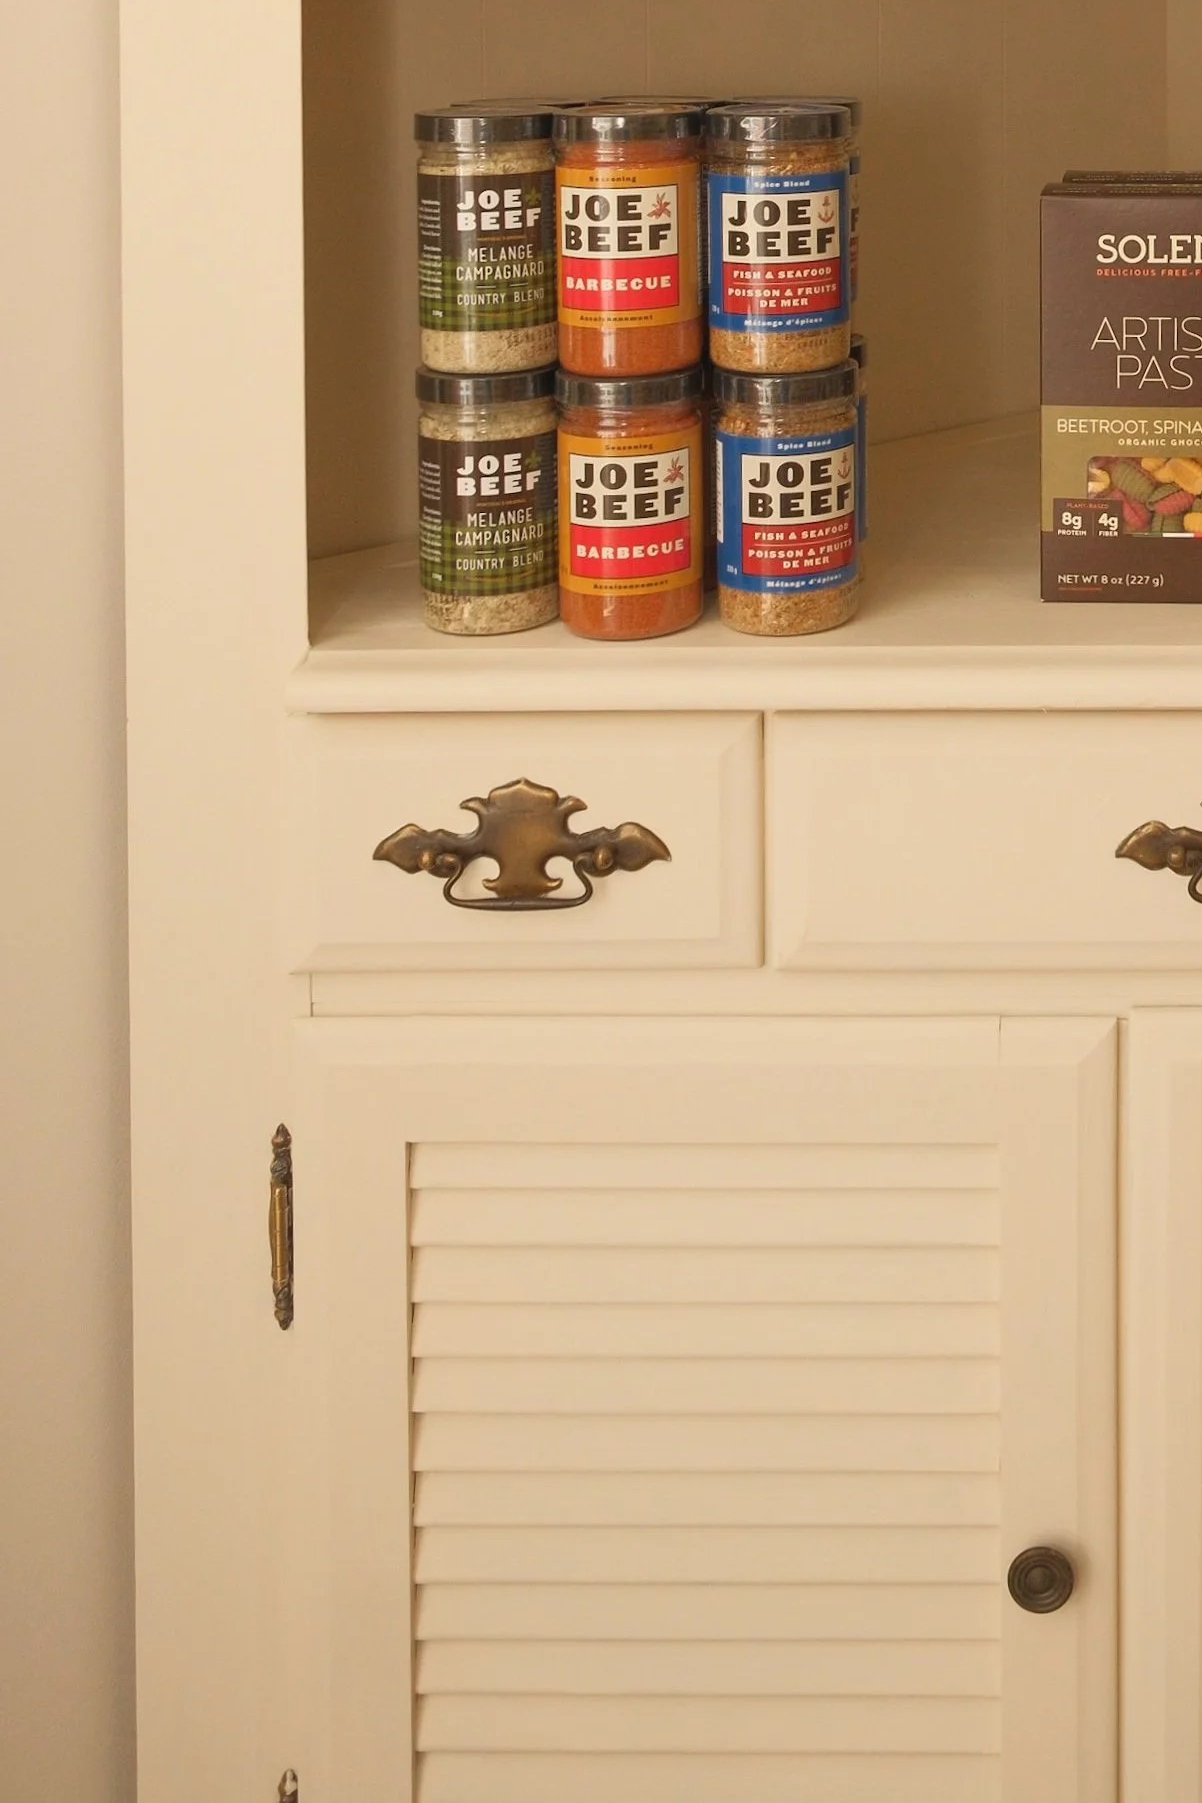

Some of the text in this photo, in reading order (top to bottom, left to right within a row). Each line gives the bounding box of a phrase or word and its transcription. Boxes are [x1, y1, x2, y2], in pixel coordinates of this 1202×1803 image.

[457, 189, 522, 211] JOE
[565, 194, 642, 222] JOE
[457, 208, 541, 231] BEEF
[728, 199, 811, 227] JOE
[565, 223, 671, 252] BEEF
[728, 227, 835, 257] BEEF
[456, 261, 544, 281] CAMPAGNARD
[733, 267, 832, 279] FISH SEAFOOD
[1096, 269, 1157, 277] DELICIOUS
[566, 276, 671, 292] BARBECUE
[728, 284, 836, 297] POISSON FRUITS
[457, 288, 545, 306] COUNTRY BLEND
[1057, 418, 1149, 436] BEETROOT,
[1118, 438, 1166, 446] ORGANIC
[457, 453, 522, 476] JOE
[748, 457, 832, 488] JOE
[456, 470, 541, 497] BEEF
[576, 461, 658, 490] JOE
[575, 487, 684, 520] BEEF
[748, 482, 852, 519] BEEF
[1061, 512, 1083, 530] 8g
[1098, 513, 1119, 530] 4g
[456, 523, 544, 546] CAMPAGNARD
[1057, 529, 1087, 537] PROTEIN
[576, 539, 684, 559] BARBECUE
[748, 549, 803, 559] POISSON
[456, 551, 544, 571] COUNTRY BLEND
[1058, 574, 1150, 587] NET WT 8 oz (227
